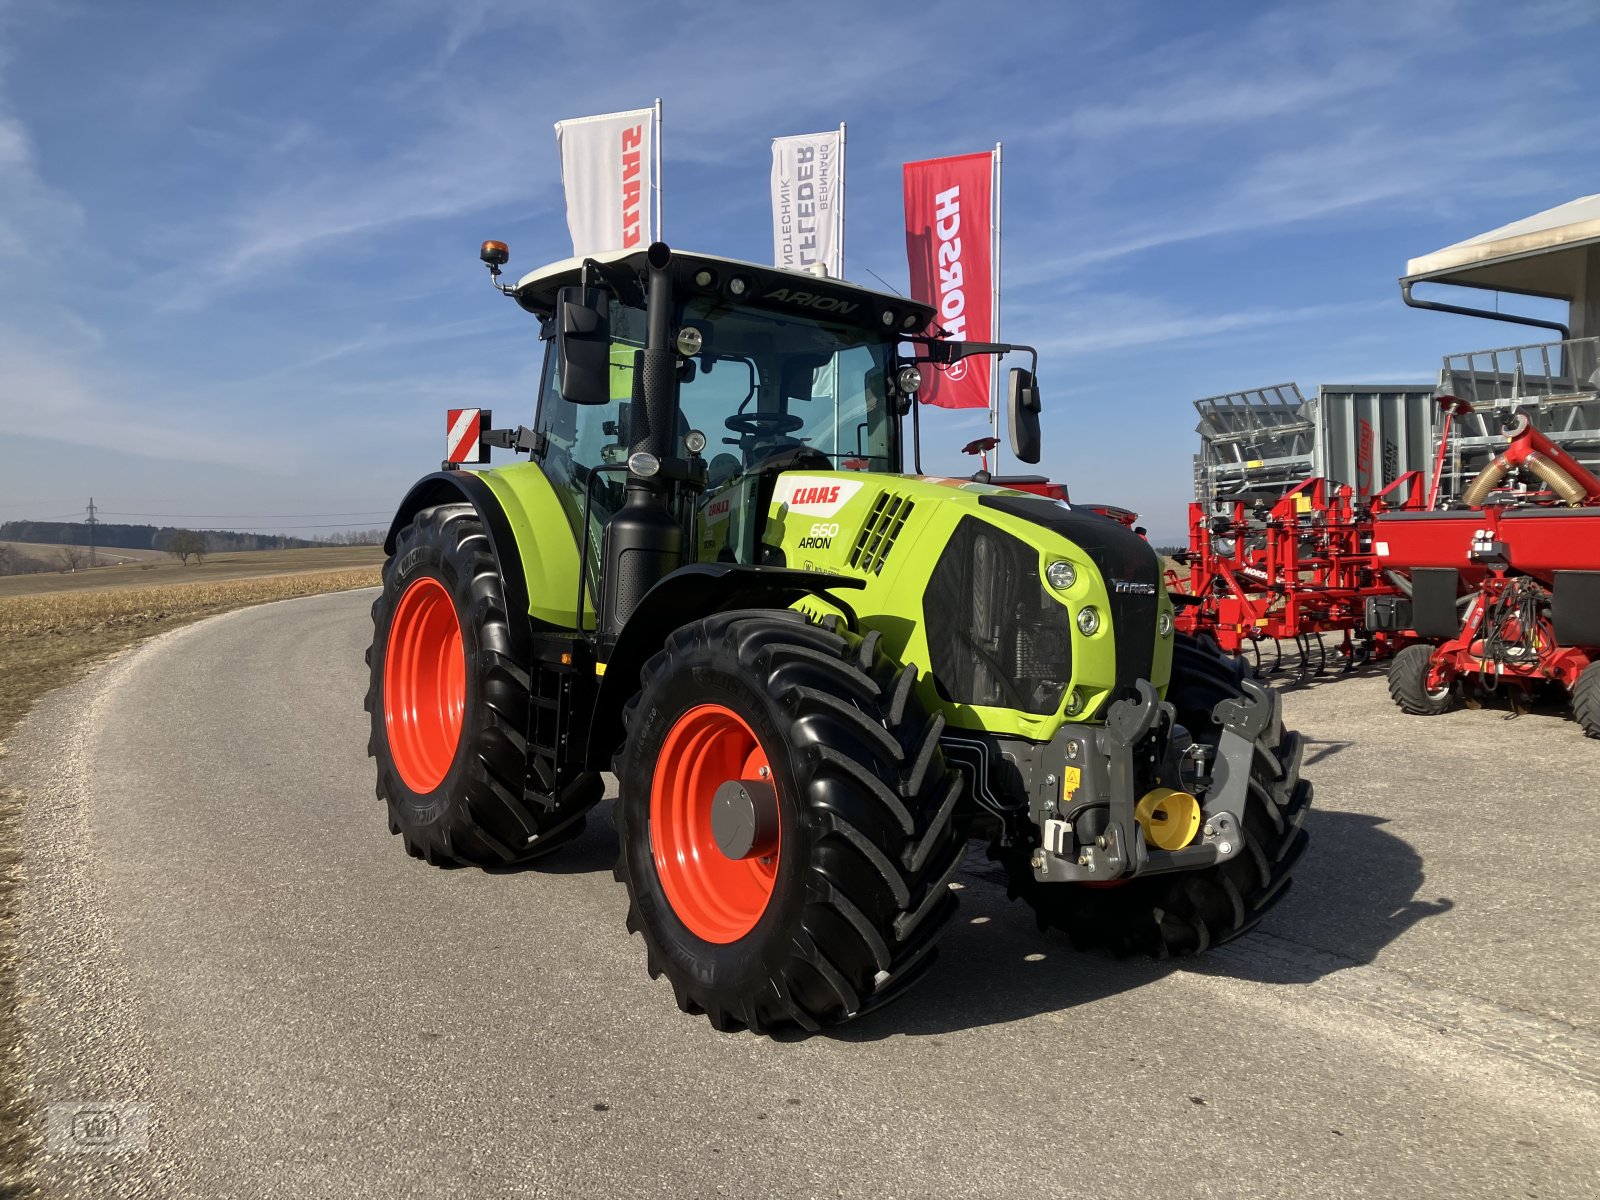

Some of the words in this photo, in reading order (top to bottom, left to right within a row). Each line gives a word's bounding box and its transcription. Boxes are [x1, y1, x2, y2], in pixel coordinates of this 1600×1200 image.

[763, 288, 859, 314] ARION
[1383, 438, 1394, 485] GIGANT
[791, 486, 841, 505] CLAAS
[810, 523, 839, 537] 660
[798, 537, 832, 549] ARION
